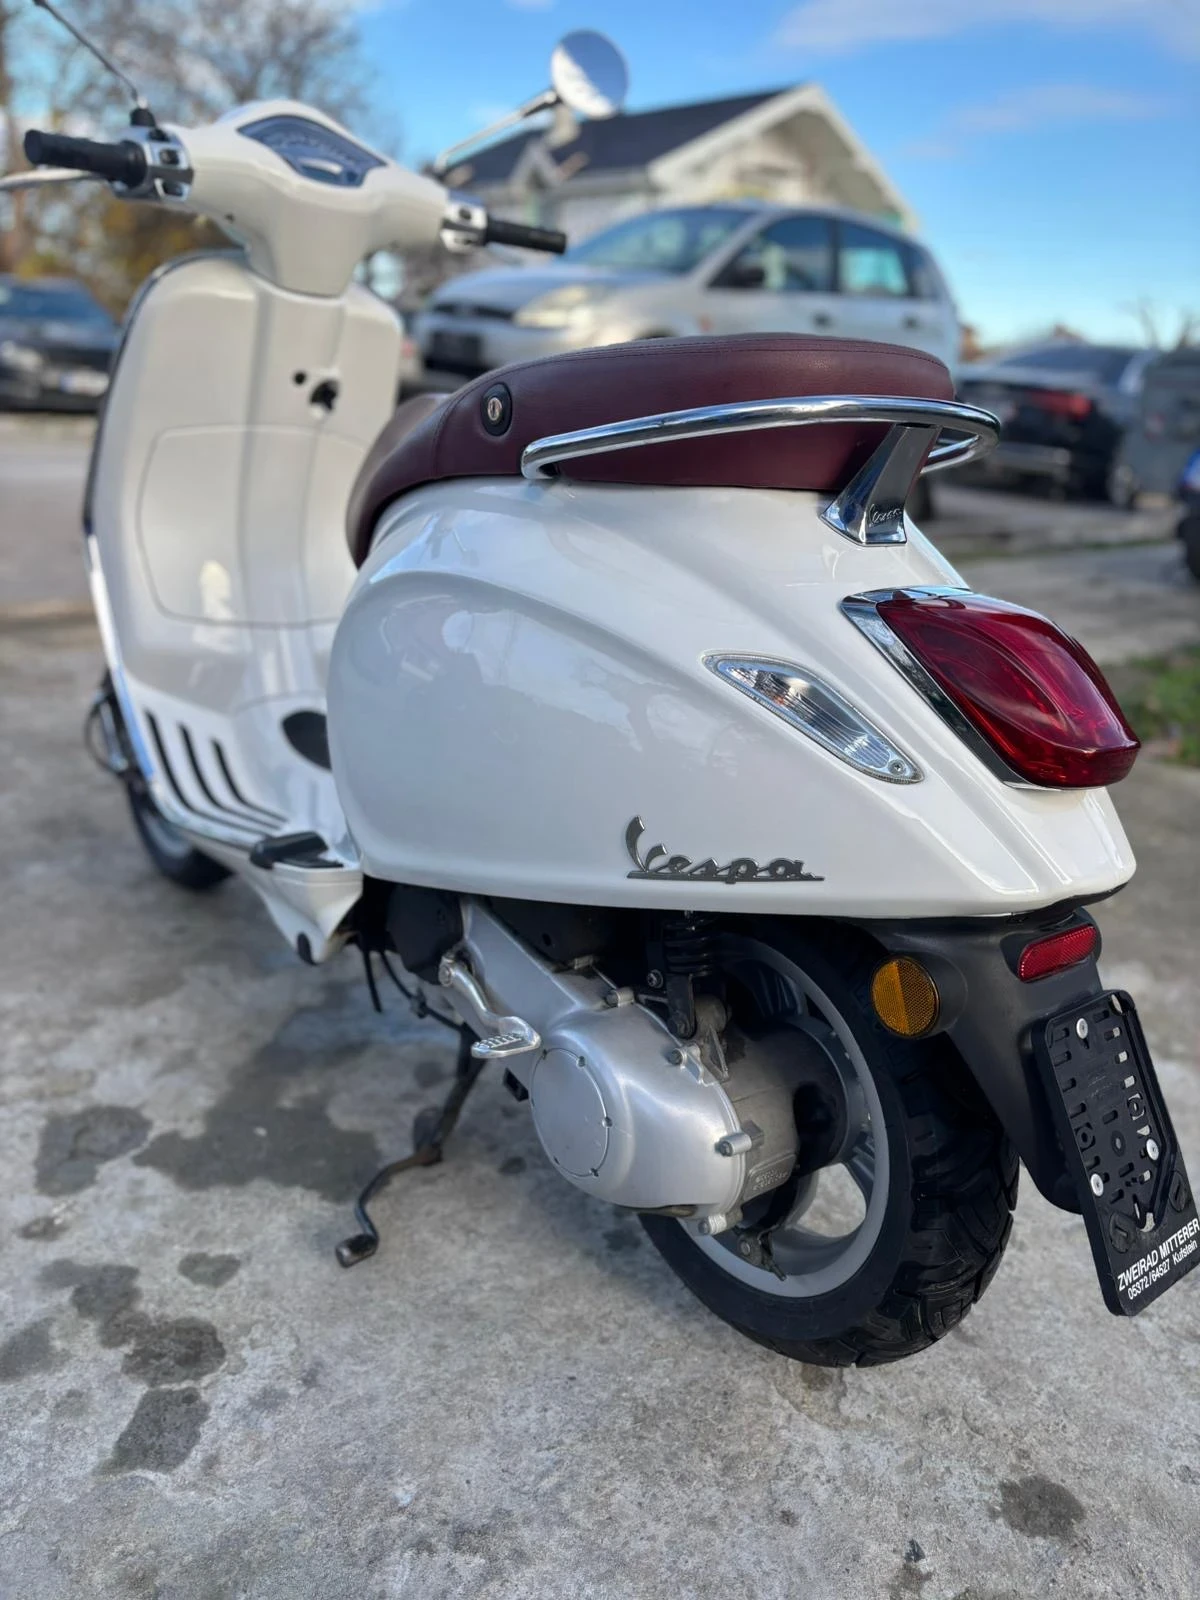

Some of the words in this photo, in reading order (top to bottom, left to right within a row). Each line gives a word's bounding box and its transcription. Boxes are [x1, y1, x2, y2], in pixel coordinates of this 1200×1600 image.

[625, 815, 825, 884] Vespa
[1117, 1249, 1158, 1291] ZWEIRAD
[1159, 1217, 1200, 1260] MITTERER
[1172, 1239, 1198, 1265] Kufstein
